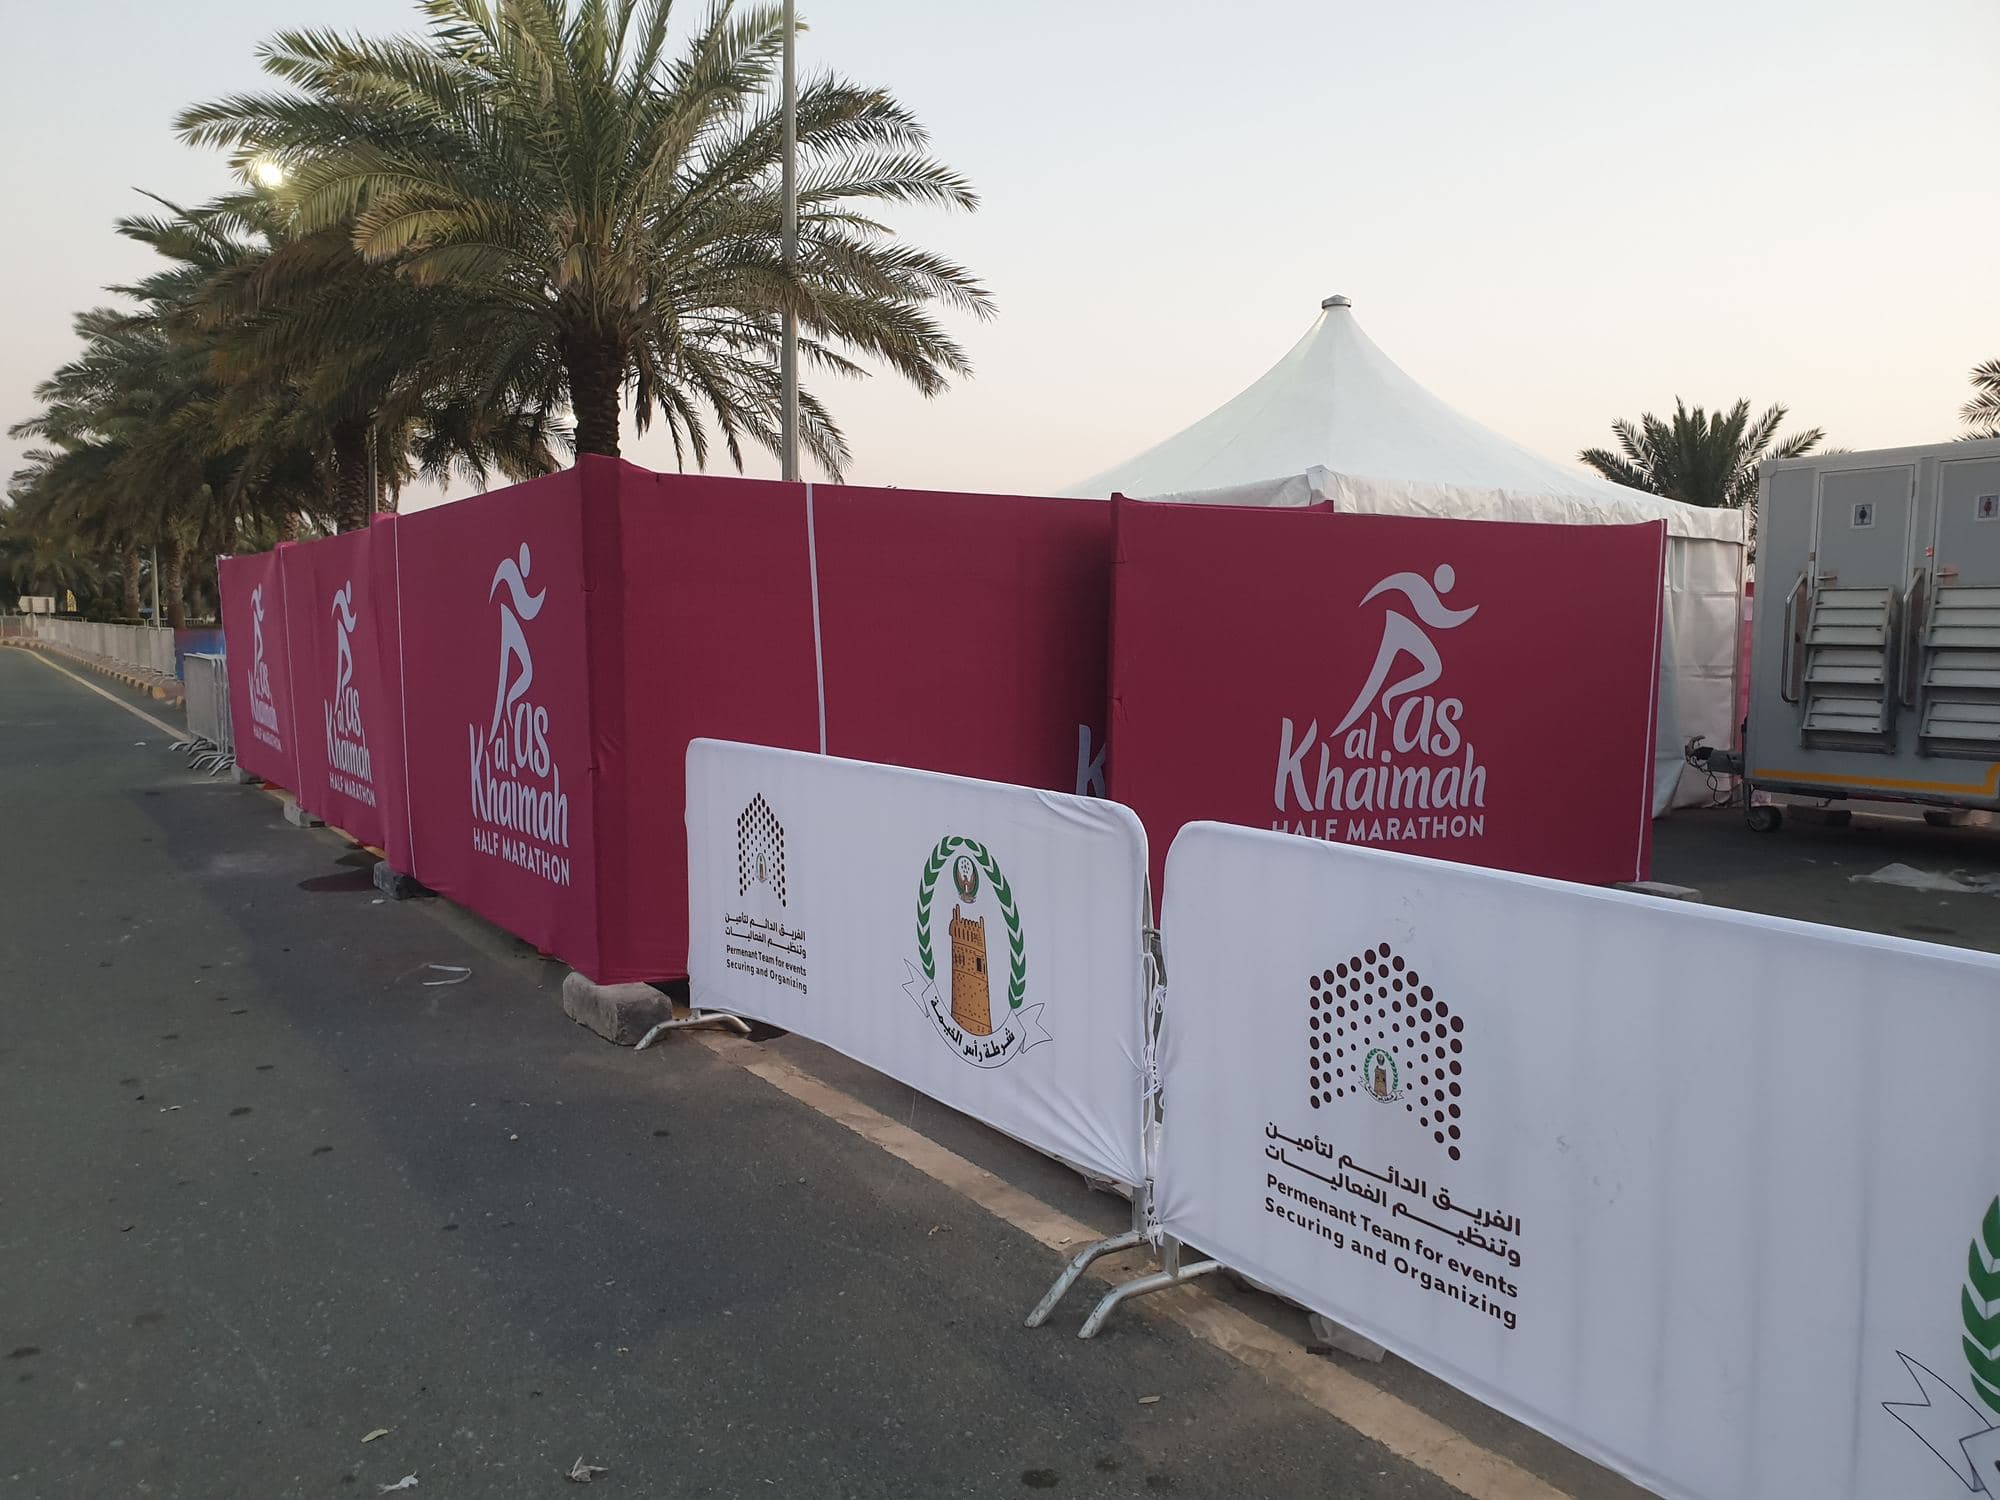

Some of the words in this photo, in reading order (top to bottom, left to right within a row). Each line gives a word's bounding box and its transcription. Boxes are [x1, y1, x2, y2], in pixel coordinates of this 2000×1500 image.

[324, 698, 373, 784] Khaimah
[494, 719, 508, 772] al
[1344, 711, 1376, 760] al
[469, 722, 569, 848] Khaimah
[1274, 717, 1486, 812] Khaimah
[1346, 814, 1485, 841] MARATHON
[473, 827, 499, 852] HALF
[502, 835, 570, 887] MARATHON
[779, 923, 806, 942] الفريق
[726, 944, 758, 960] Permenant
[758, 951, 775, 965] Team
[775, 956, 785, 968] for
[785, 962, 807, 977] events
[726, 958, 755, 976] Securing
[755, 967, 768, 977] and
[769, 969, 807, 994] Organizing
[930, 996, 963, 1046] الخيمة
[983, 1027, 1015, 1058] شرطة
[962, 1039, 983, 1062] رأس
[1265, 1121, 1333, 1159] لتأمين
[1265, 1144, 1387, 1207] الفعاليات
[1338, 1154, 1426, 1198] الدائم
[1267, 1173, 1357, 1226] Permenant
[1360, 1214, 1410, 1251] Team
[1414, 1238, 1444, 1265] for
[1448, 1257, 1518, 1298] events
[1392, 1202, 1521, 1267] وتنظيم
[1432, 1187, 1521, 1237] الفريق
[1265, 1196, 1344, 1249] Securing
[1350, 1235, 1387, 1266] and
[1393, 1256, 1517, 1330] Organizing
